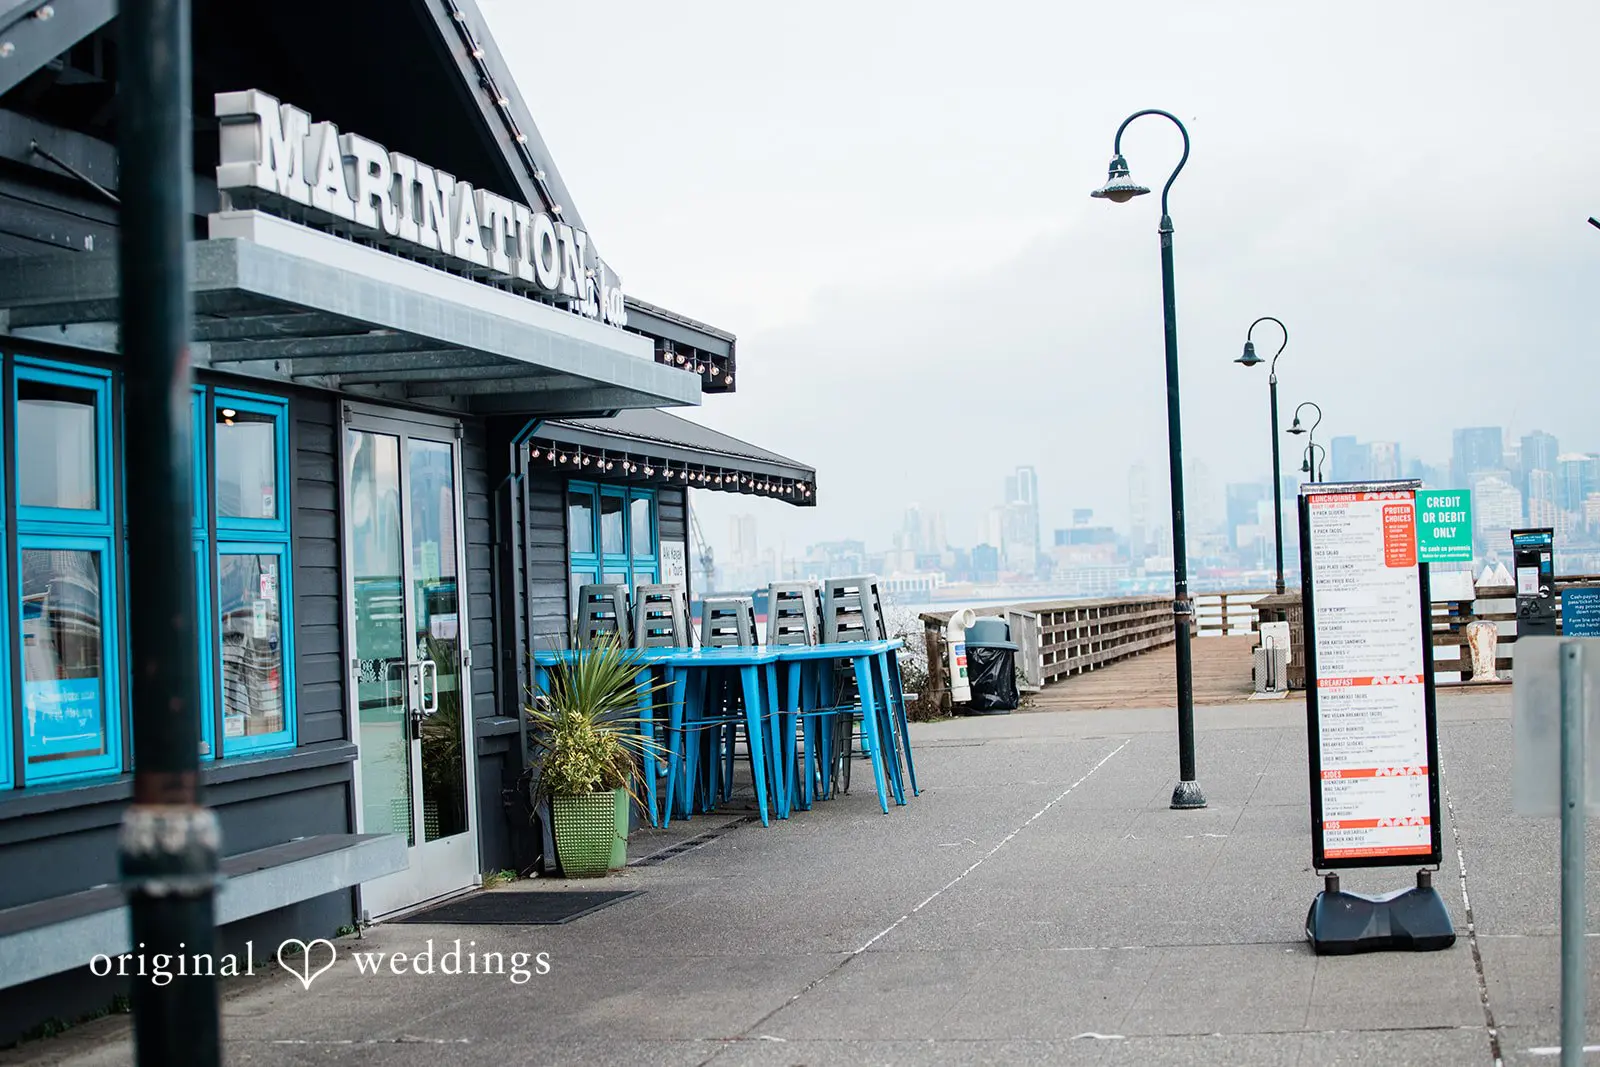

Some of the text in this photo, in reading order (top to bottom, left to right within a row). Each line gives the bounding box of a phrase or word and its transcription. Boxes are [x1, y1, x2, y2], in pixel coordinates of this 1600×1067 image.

[214, 88, 588, 300] MARINATION
[1311, 493, 1357, 503] LUNCH/DINNER
[1426, 496, 1460, 508] CREDIT
[1384, 506, 1411, 514] PROTEIN
[1385, 515, 1412, 523] CHOICES
[1422, 511, 1466, 523] OR DEBIT
[1433, 527, 1456, 538] ONLY
[1320, 678, 1353, 687] BREAKFAST
[1323, 770, 1342, 779] SIDES
[1325, 822, 1340, 830] KIDS
